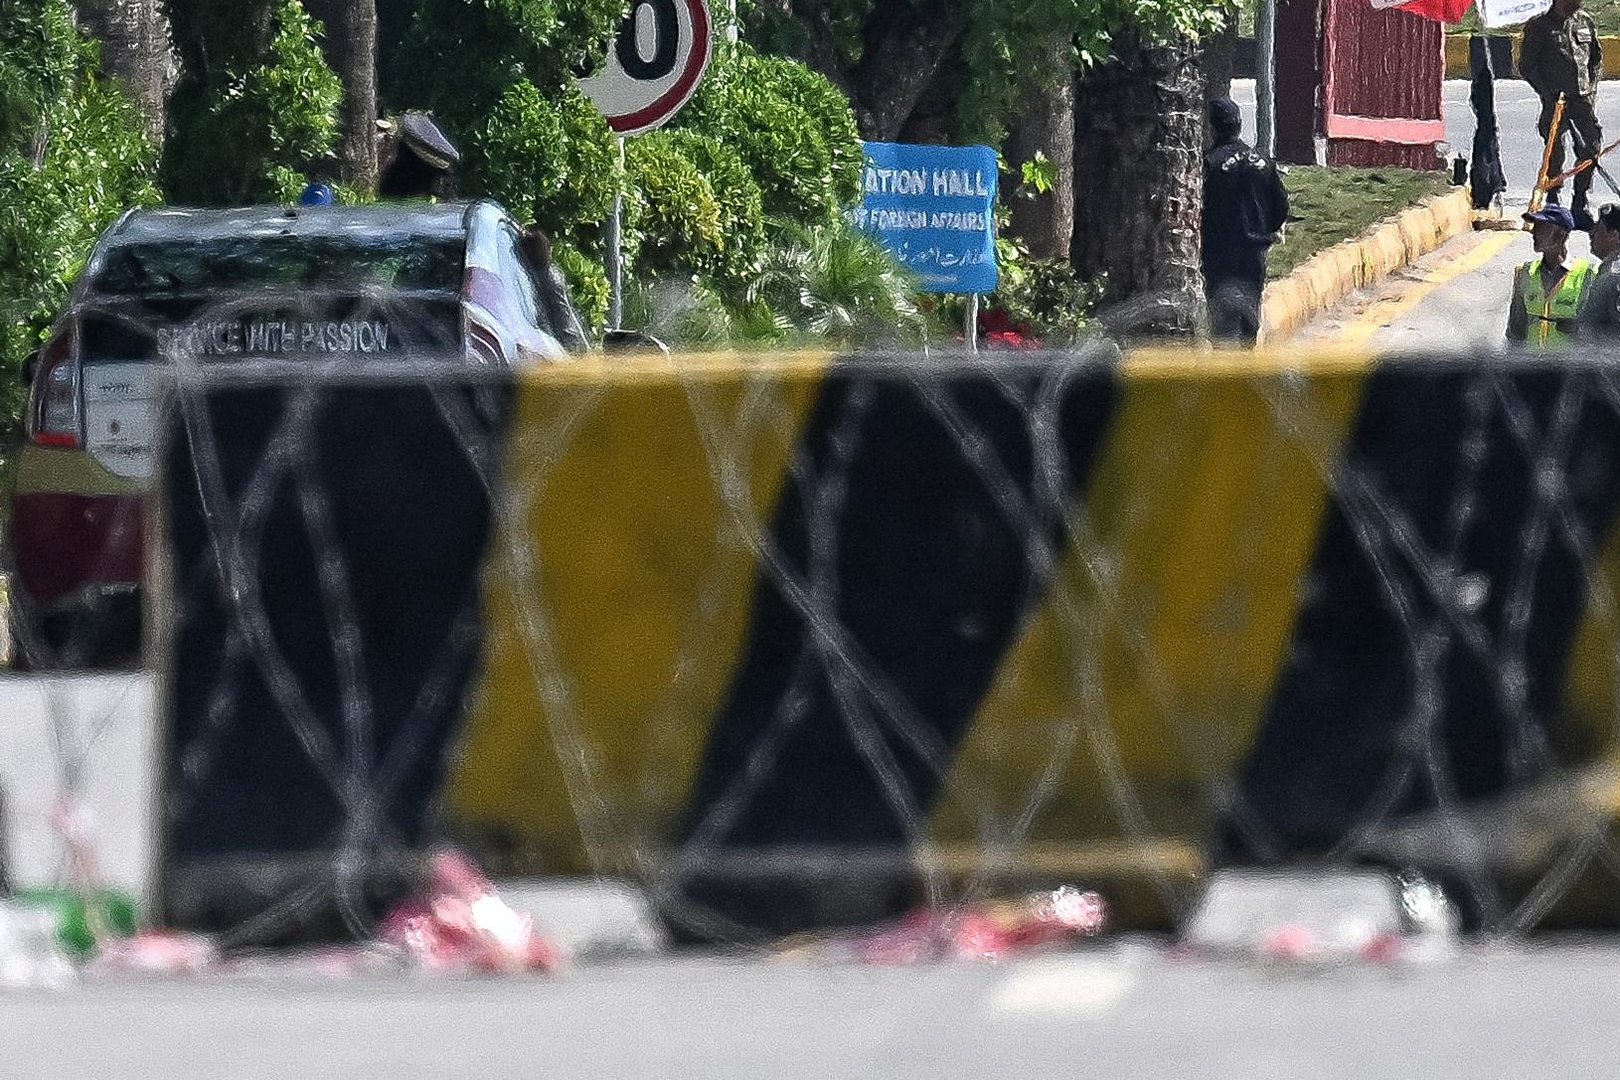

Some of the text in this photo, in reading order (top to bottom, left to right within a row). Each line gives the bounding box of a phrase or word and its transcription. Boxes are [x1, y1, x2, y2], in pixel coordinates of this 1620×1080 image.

[864, 167, 988, 196] ATION HALL
[301, 320, 390, 353] PASSION
